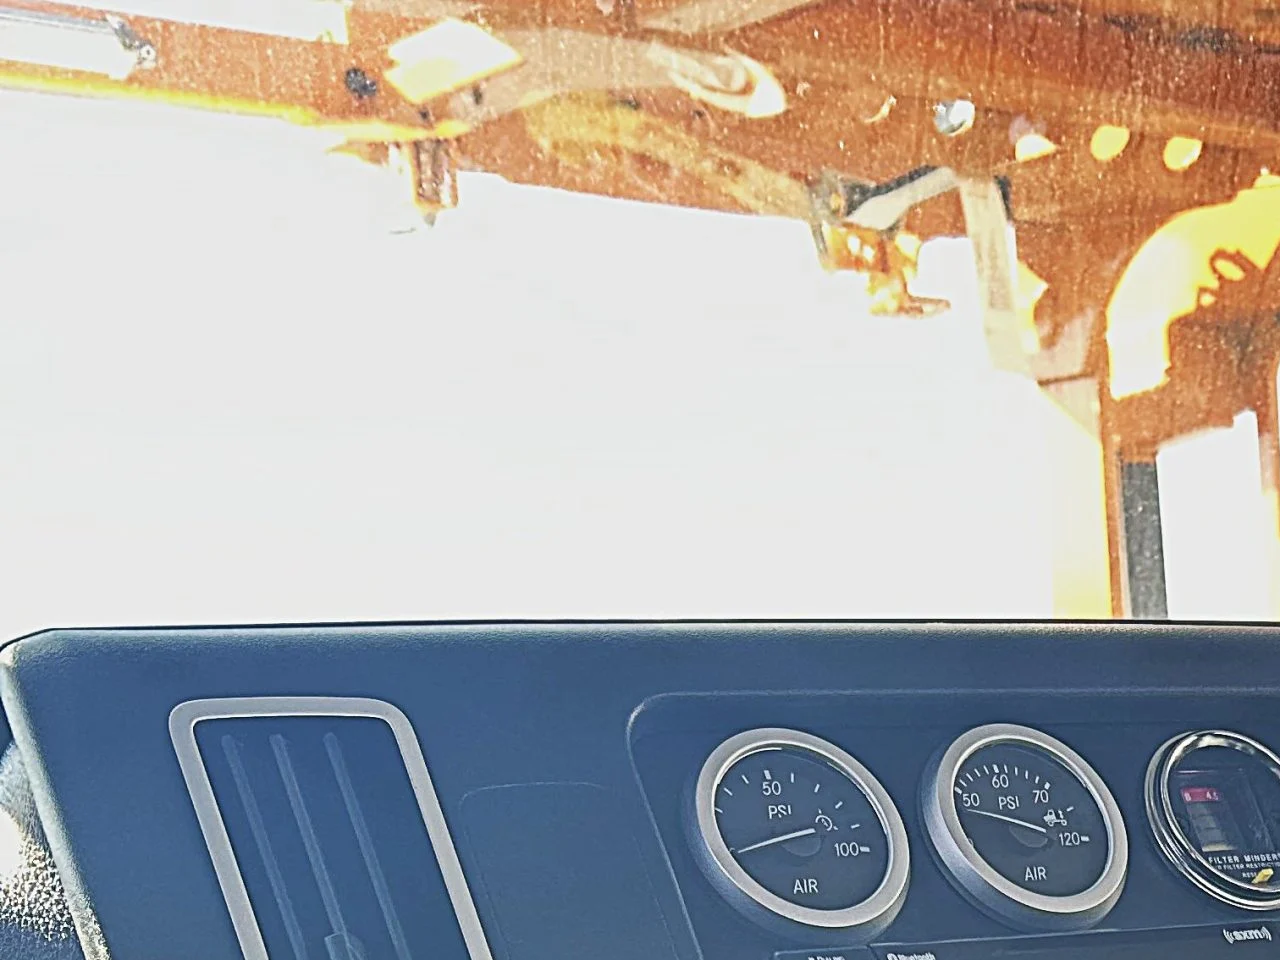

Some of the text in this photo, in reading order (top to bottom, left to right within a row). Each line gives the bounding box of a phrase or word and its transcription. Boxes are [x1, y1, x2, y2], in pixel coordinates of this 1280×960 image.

[761, 781, 782, 796] 50
[992, 774, 1009, 788] 60
[962, 793, 980, 808] 50
[998, 796, 1020, 810] PSI
[1032, 790, 1049, 804] 70
[768, 804, 792, 820] PSI
[1058, 832, 1080, 846] 120
[834, 842, 859, 857] 100
[1208, 855, 1240, 864] FILTER
[1025, 866, 1047, 881] AIR
[792, 879, 820, 895] AIR
